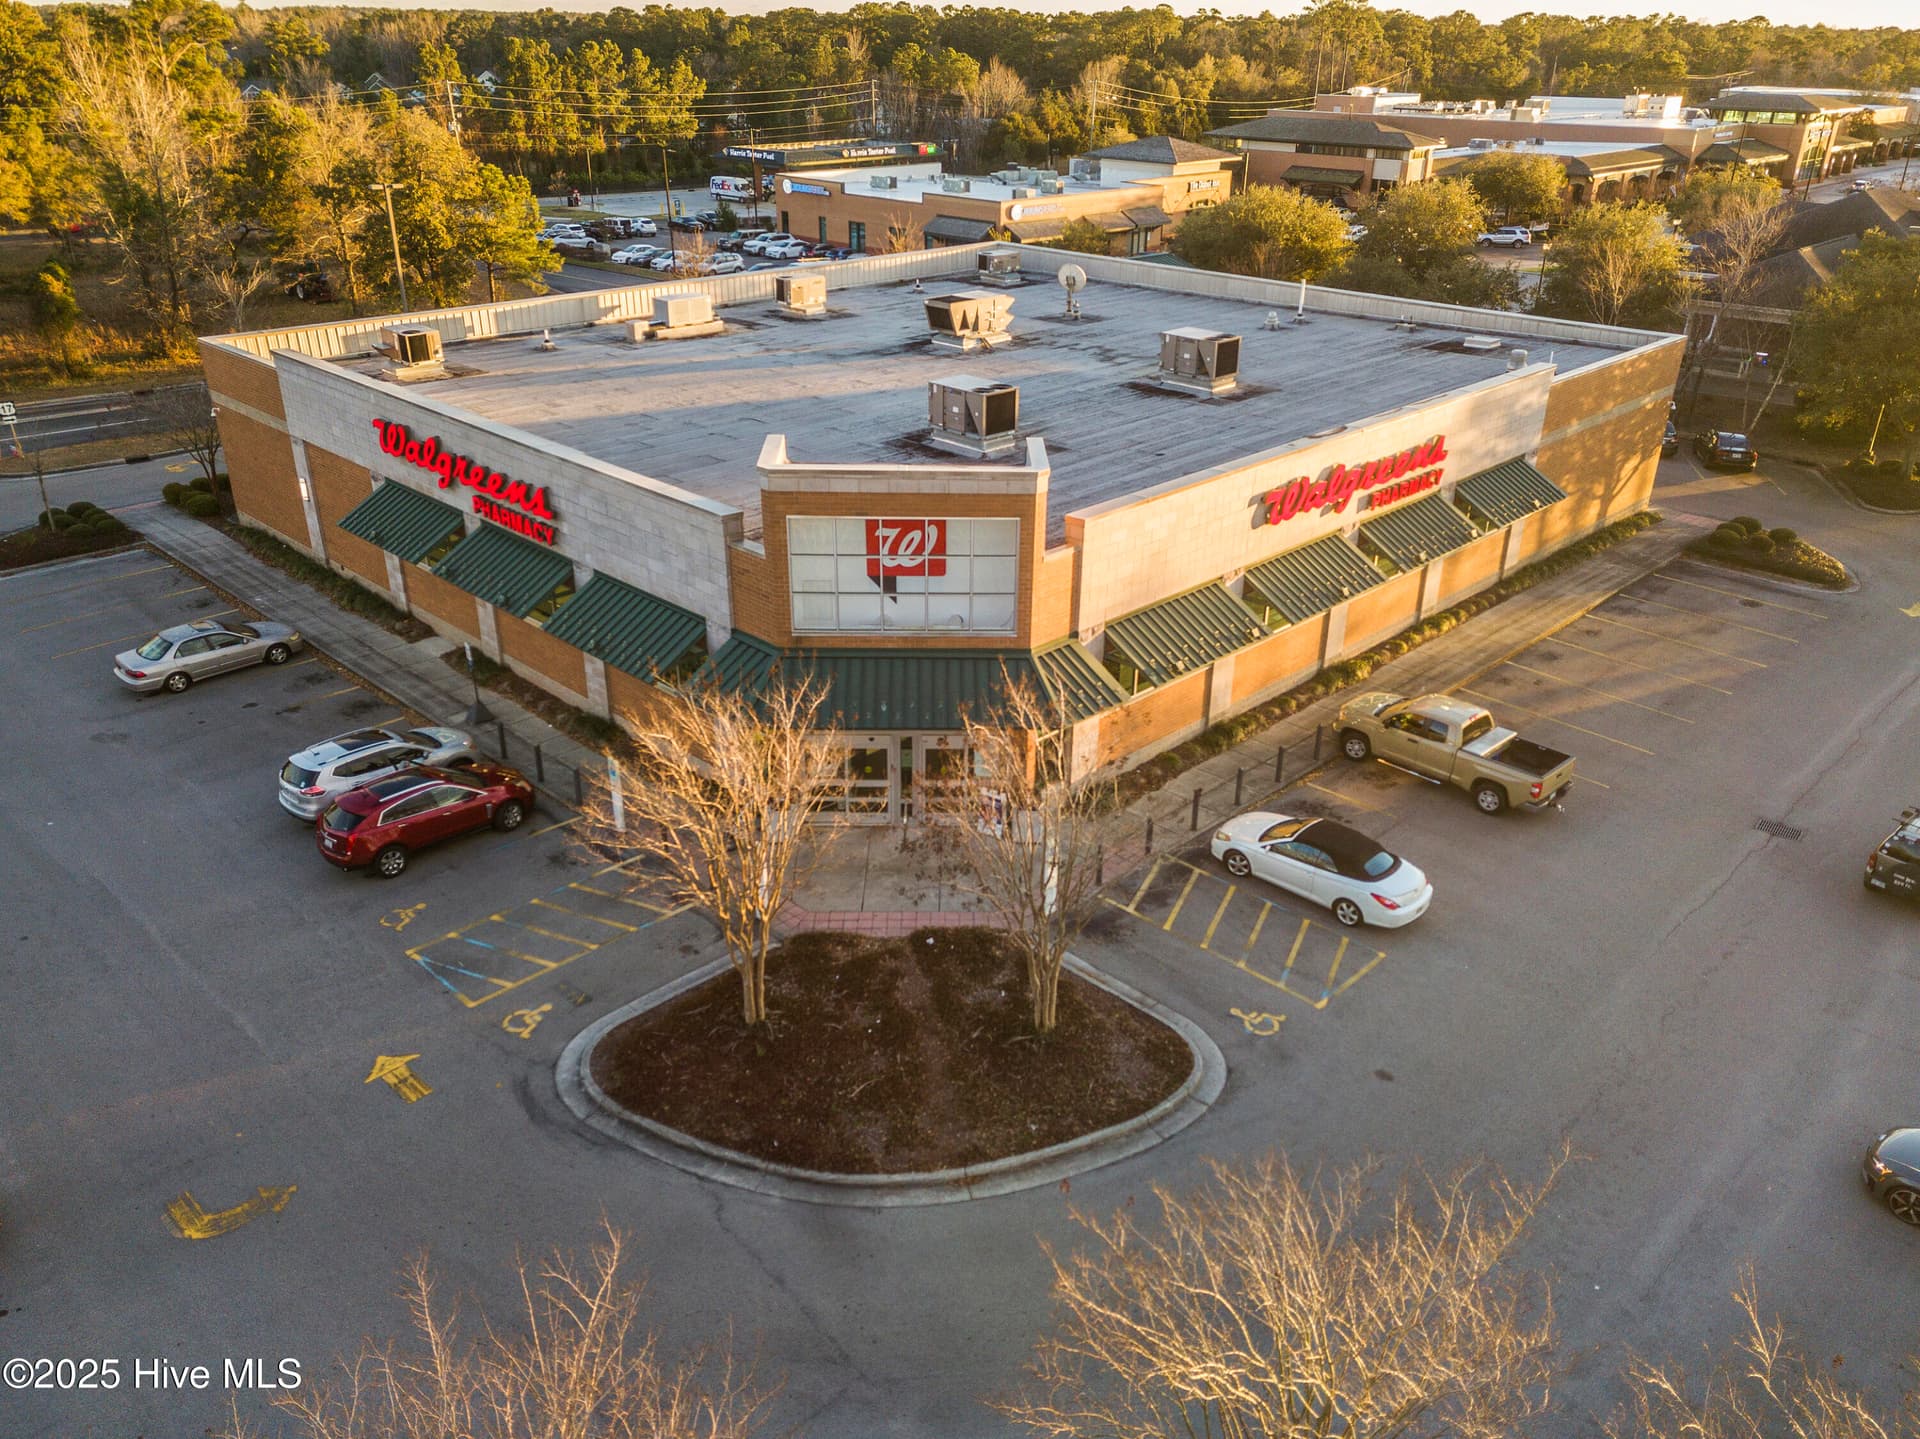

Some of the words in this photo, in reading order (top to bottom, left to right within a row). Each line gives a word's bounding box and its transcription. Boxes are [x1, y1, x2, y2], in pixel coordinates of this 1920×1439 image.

[730, 149, 746, 157] Harris
[763, 152, 774, 160] Fuel
[711, 179, 731, 191] FedEx
[372, 418, 553, 519] Walgreens
[1265, 435, 1448, 525] Walgreens
[1371, 468, 1444, 511] PHARMACY
[472, 495, 554, 546] PHARMACY
